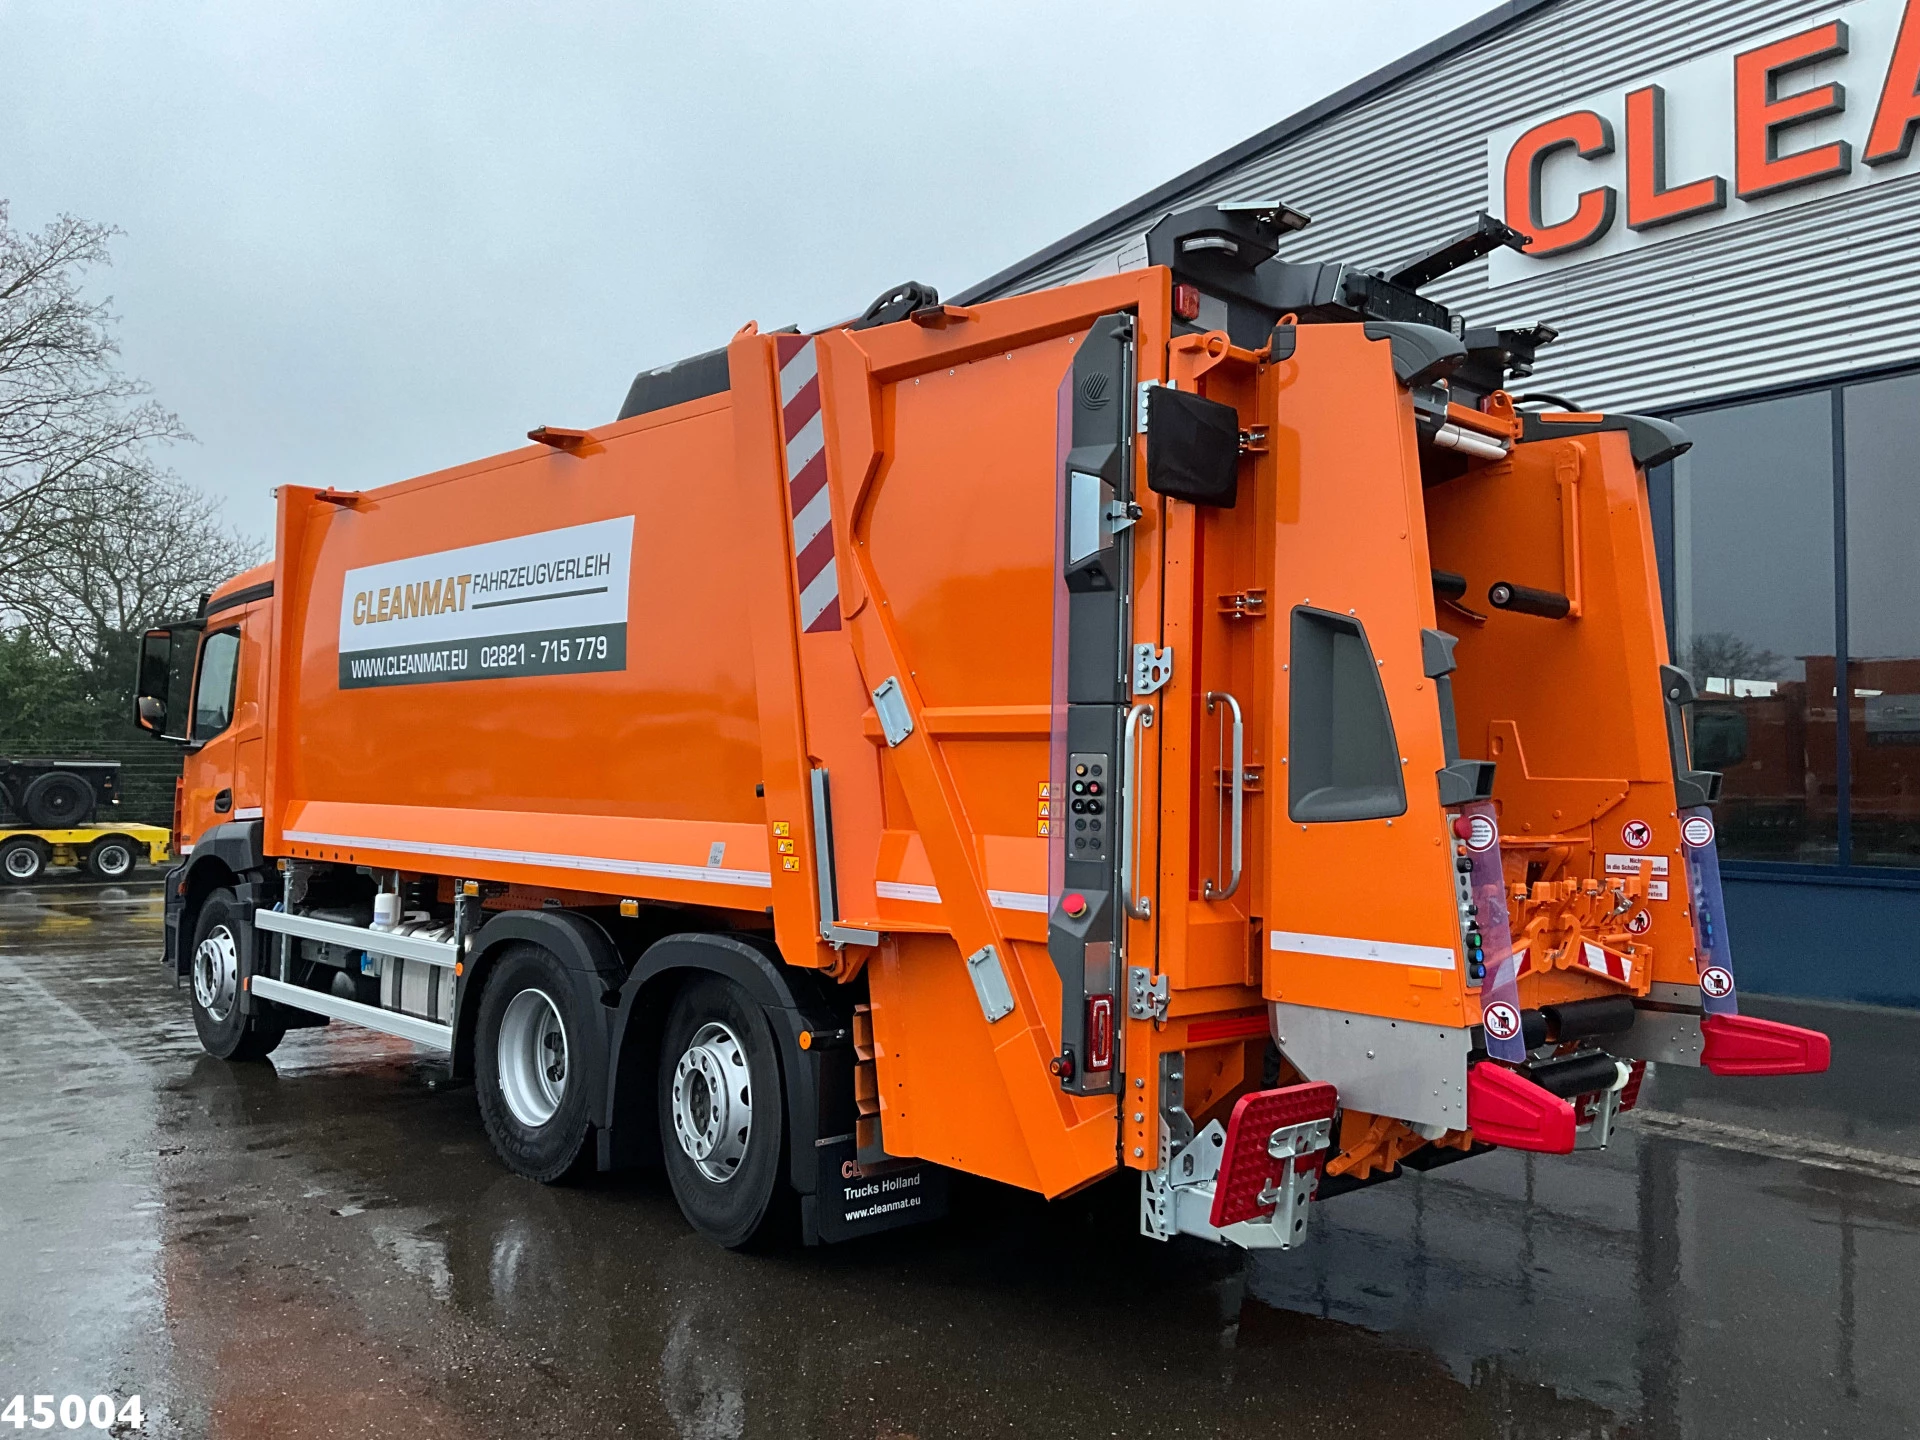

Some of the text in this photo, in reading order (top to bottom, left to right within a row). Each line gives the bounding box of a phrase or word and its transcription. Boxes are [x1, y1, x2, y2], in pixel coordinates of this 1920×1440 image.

[352, 552, 611, 626] CLEANMAT FAHRZEUGVERLEIH
[351, 648, 468, 679] WWW.CLEANMAT.EU
[480, 643, 526, 668] 02821
[541, 639, 570, 664] 715
[575, 635, 608, 660] 779
[844, 1173, 920, 1200] Trucks Holland
[845, 1197, 921, 1221] www.cleanmat.eu
